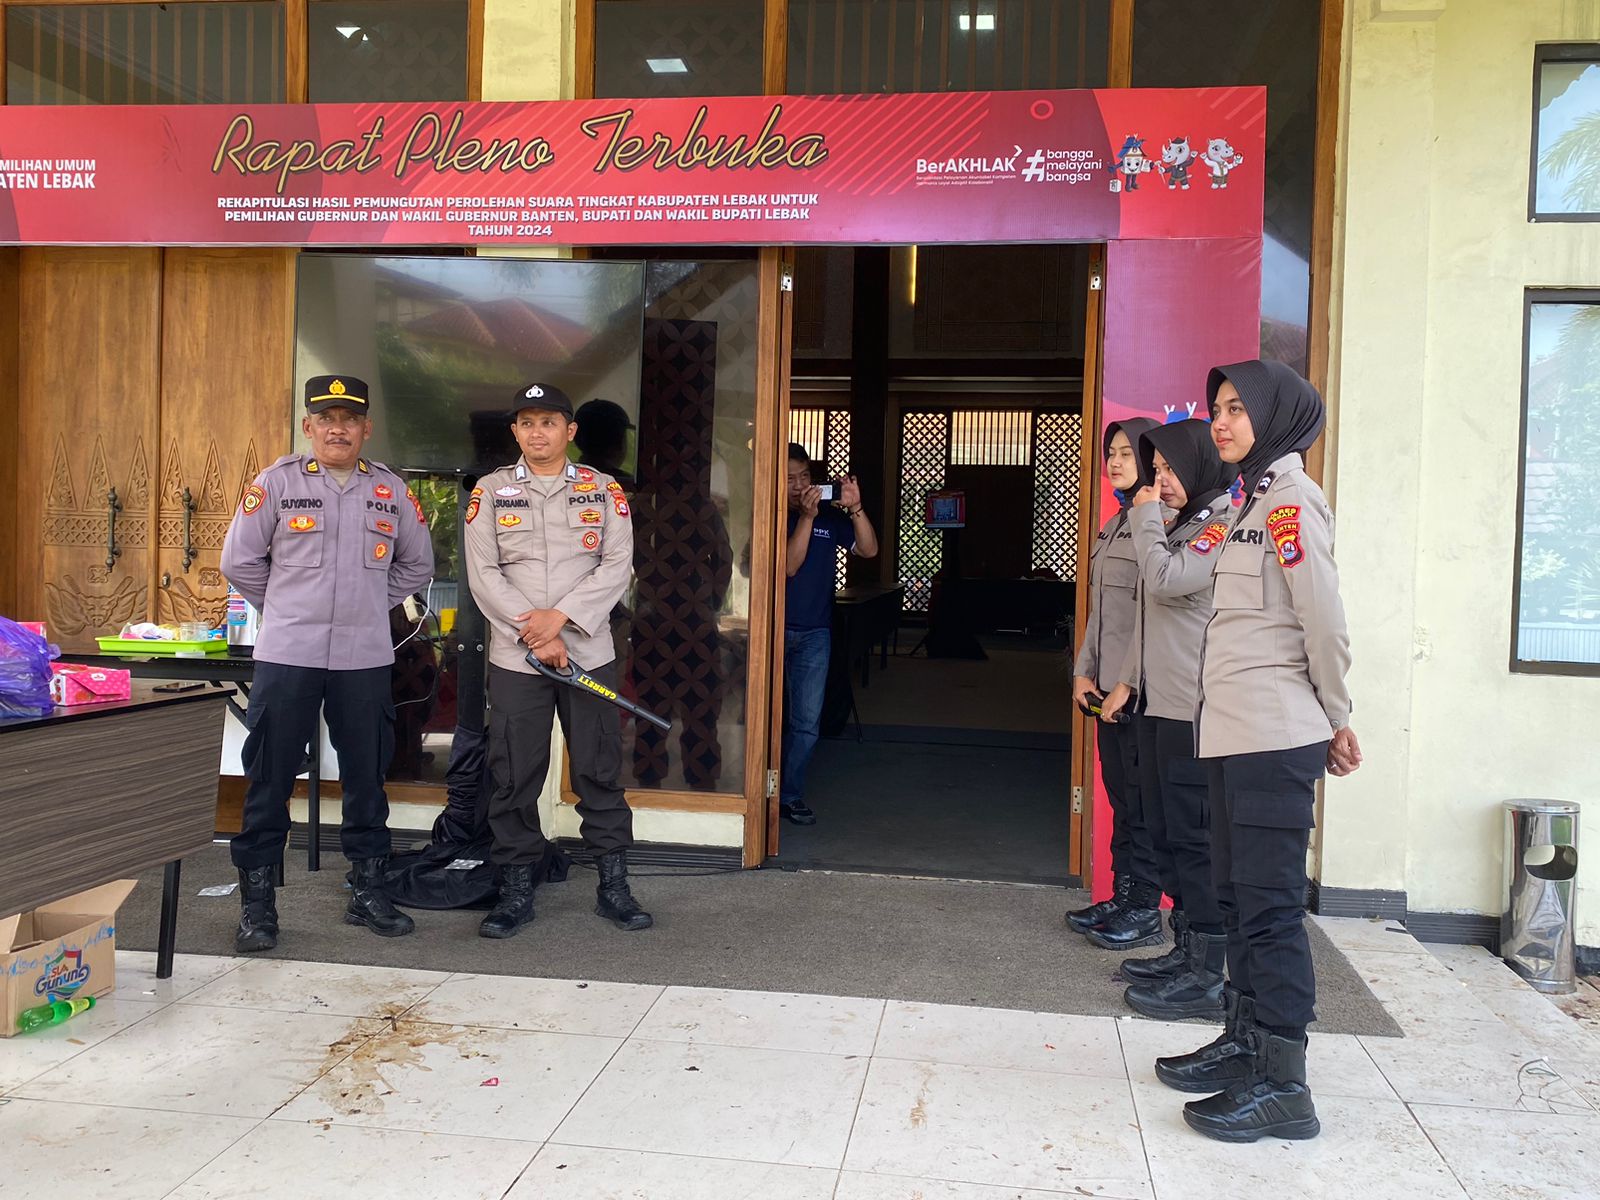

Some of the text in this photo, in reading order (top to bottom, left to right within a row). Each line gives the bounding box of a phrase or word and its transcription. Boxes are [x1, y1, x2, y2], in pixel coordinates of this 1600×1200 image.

[212, 104, 829, 194] Rapat Pleno Terbuka
[1047, 149, 1094, 161] bangga
[0, 159, 96, 171] MILIHAN UMUM
[916, 157, 1016, 173] BerAKHLAK
[1046, 159, 1102, 173] melayani
[43, 173, 96, 189] LEBAK
[1046, 172, 1091, 184] bangsa
[217, 193, 819, 208] REKAPITULASI HASIL PEMUNGUTAN PEROLEHAN SUARA TINGKAT KABUPATEN LEBAK UNTUK
[224, 207, 810, 223] PEMILIHAN GUBERNUR DAN WAKIL GUBERNUR BANTEN, BUPATI DAN WAKIL BUPATI LEBAK
[467, 224, 553, 236] TAHUN 2024
[280, 498, 323, 510] SUYATNO
[569, 493, 606, 506] POLRI
[366, 500, 400, 515] POLRI
[577, 674, 617, 700] GARRETT
